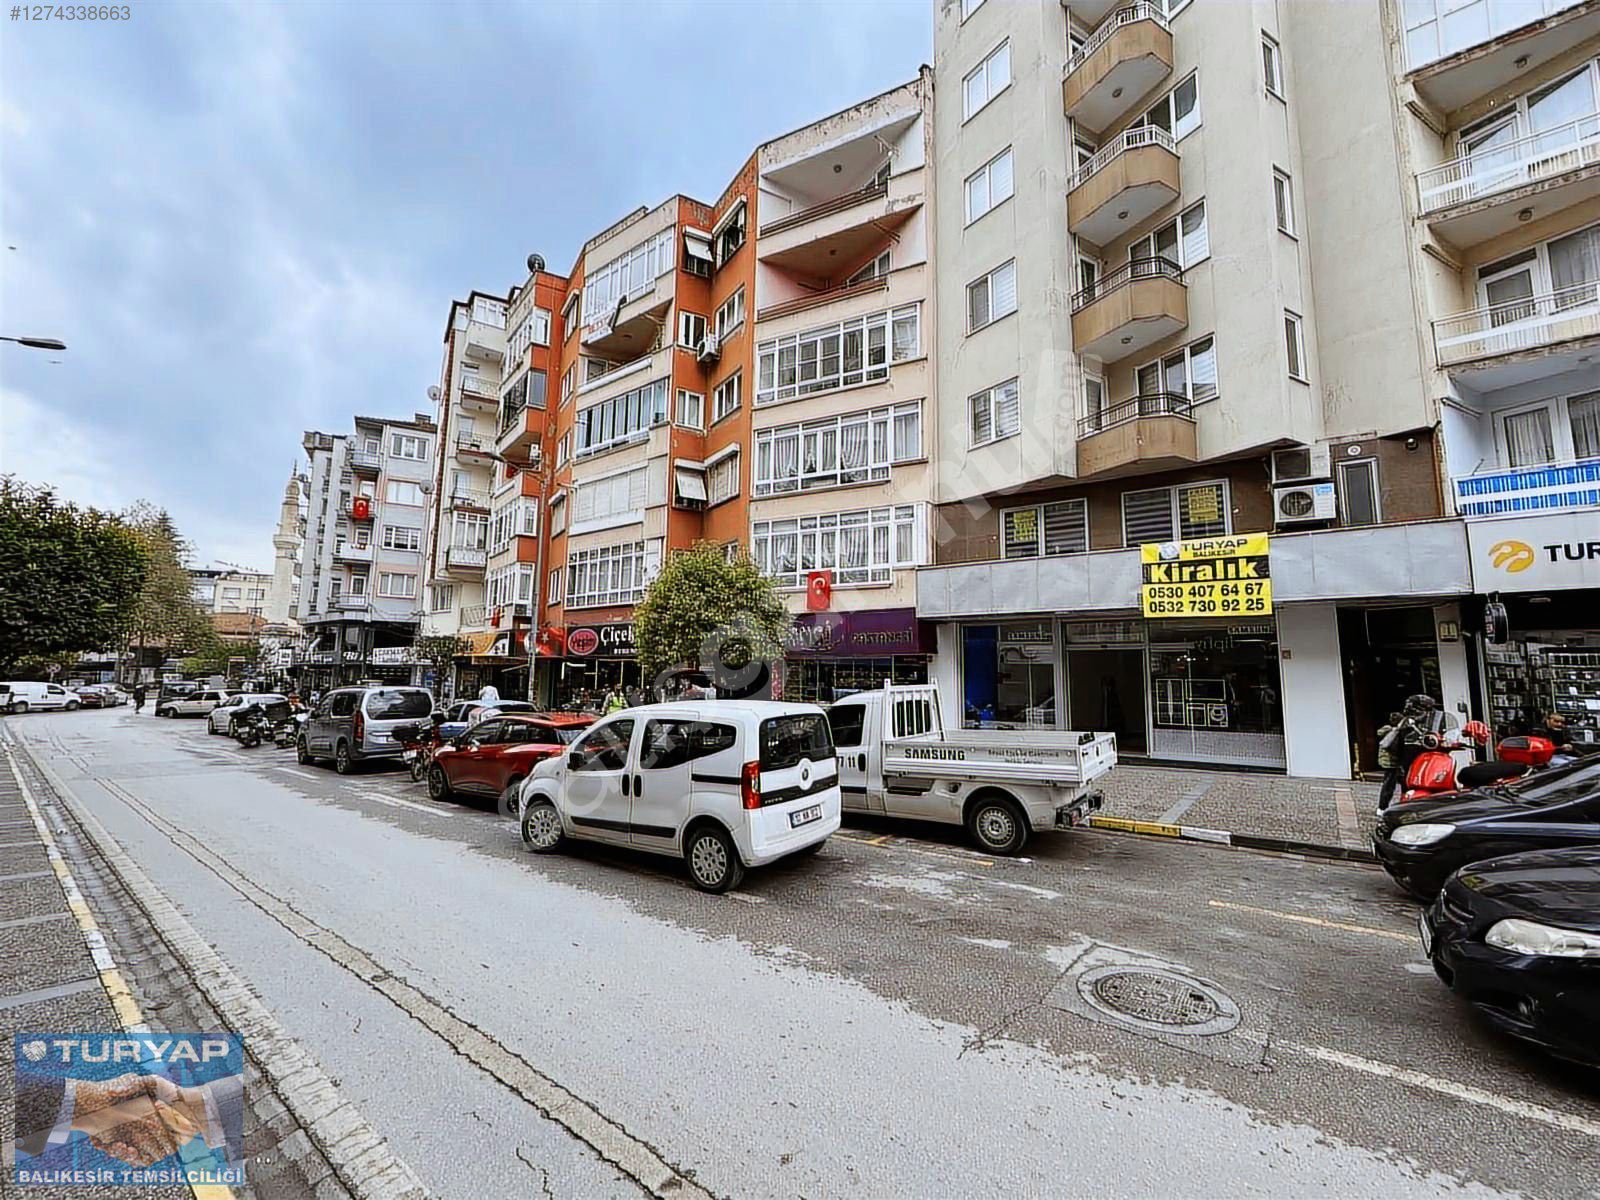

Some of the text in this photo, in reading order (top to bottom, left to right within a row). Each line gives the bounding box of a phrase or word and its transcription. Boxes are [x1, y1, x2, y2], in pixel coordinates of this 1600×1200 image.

[1181, 538, 1248, 551] TURYAP
[1543, 541, 1600, 562] TUR
[1151, 558, 1259, 583] Kiralık
[1149, 582, 1264, 599] 0530 407 64 67
[1149, 598, 1265, 613] 0532 730 92 25
[904, 748, 966, 761] SAMSUNG
